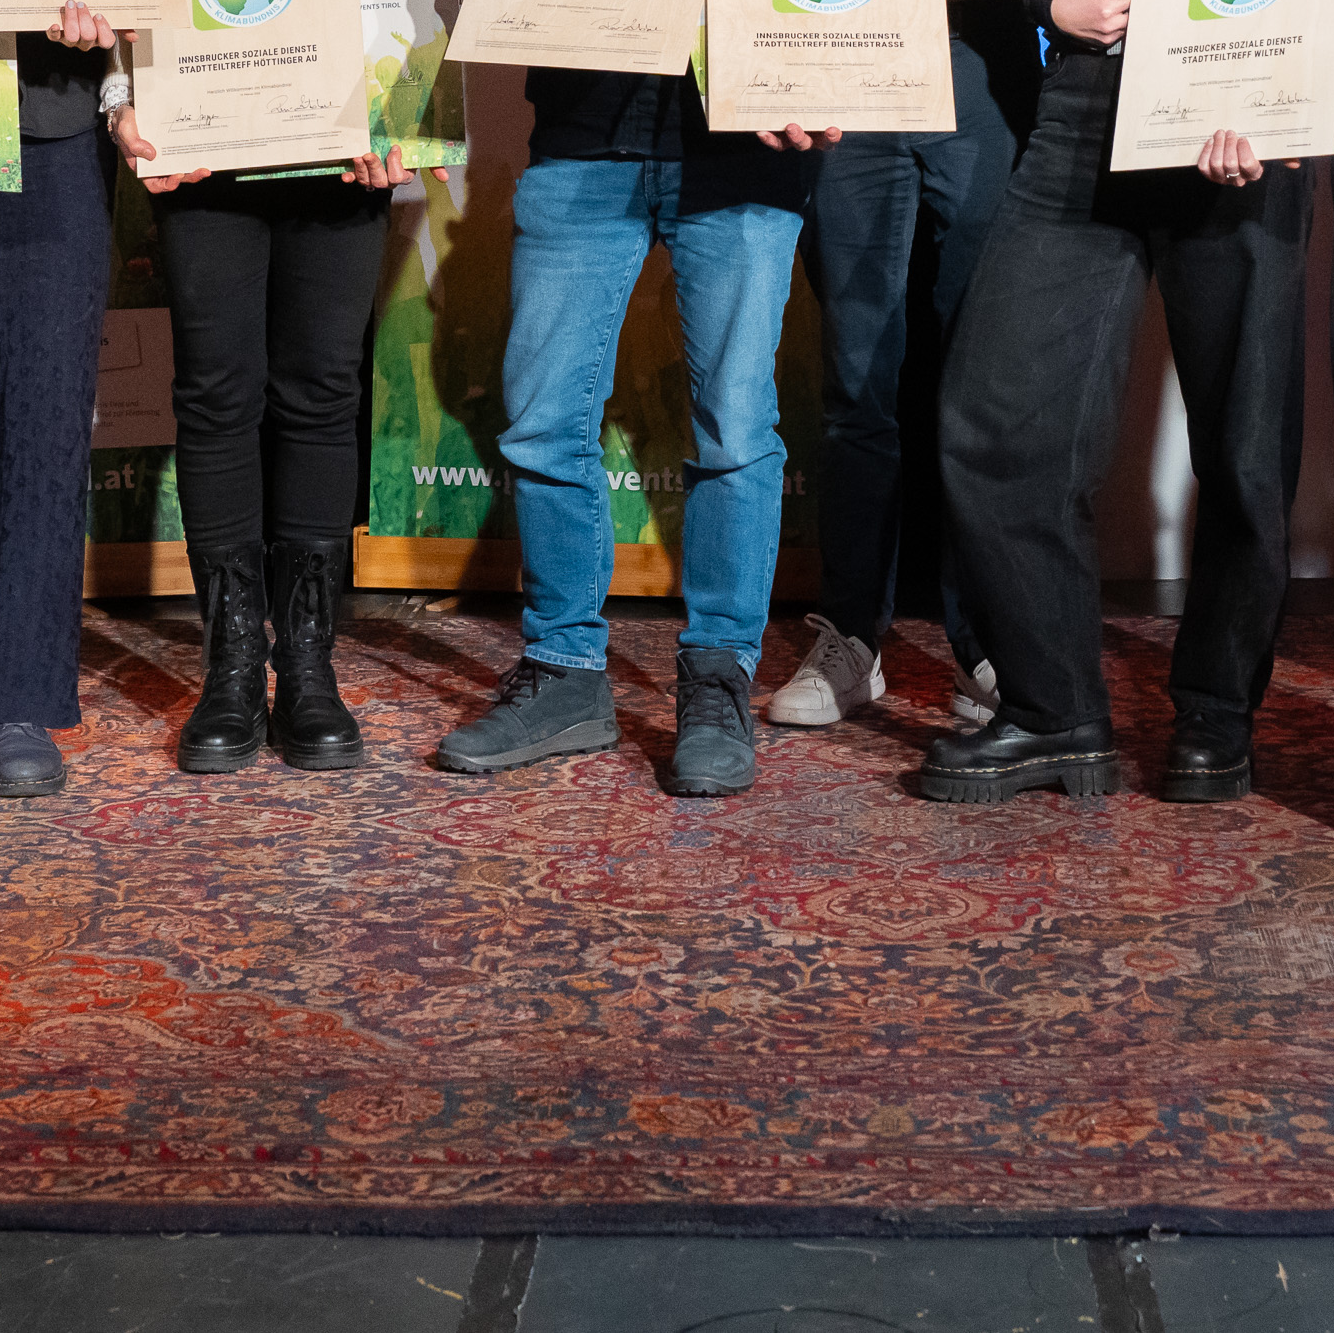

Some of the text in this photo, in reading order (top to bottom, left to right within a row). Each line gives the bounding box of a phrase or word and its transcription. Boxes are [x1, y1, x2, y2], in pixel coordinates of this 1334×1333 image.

[214, 3, 280, 25] KLIMABÜNDNIS
[179, 45, 317, 64] INNSBRUCKER SOZIALE DIENSTE
[1168, 36, 1302, 55] INNSBRUCKER SOZIALE DIENSTE
[180, 61, 251, 74] STADTTEILTREFF
[254, 56, 303, 67] HÖTTINGER
[1182, 48, 1285, 64] STADTTEILTREFF WILTEN
